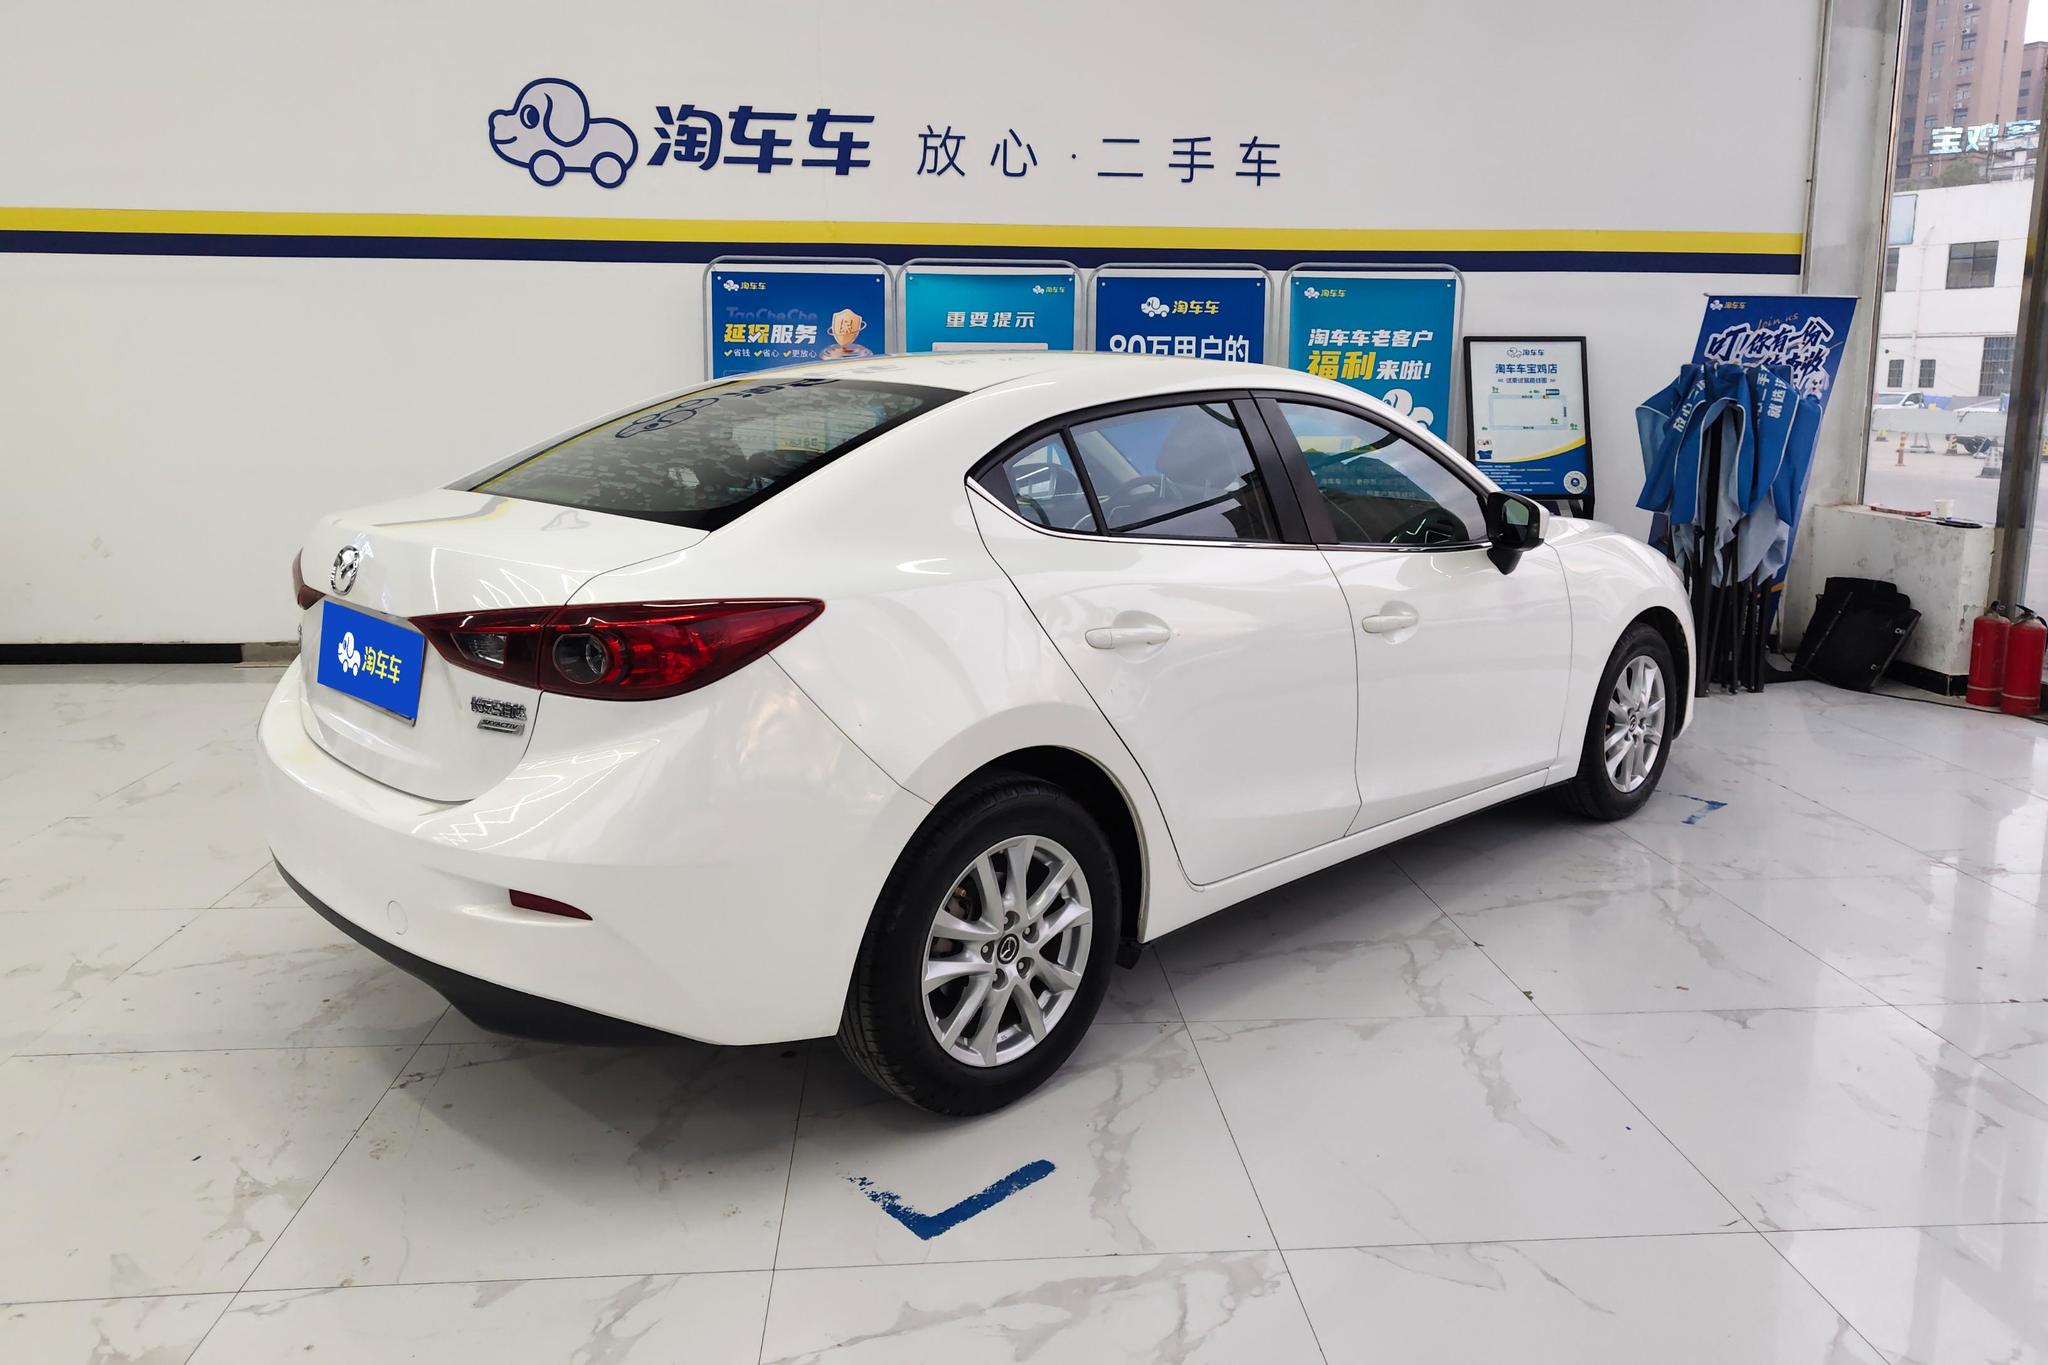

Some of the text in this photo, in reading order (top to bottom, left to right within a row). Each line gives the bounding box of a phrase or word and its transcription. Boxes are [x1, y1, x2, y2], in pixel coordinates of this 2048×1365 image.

[648, 104, 875, 176] 淘车车
[740, 281, 767, 290] 淘车车
[1045, 286, 1066, 295] 淘车车
[1320, 288, 1347, 298] 淘车车
[1172, 300, 1220, 315] 淘车车
[945, 311, 1035, 328] 重要提示
[724, 323, 817, 344] 延保服务
[1307, 329, 1433, 348] 淘车车老客户
[734, 348, 817, 359] 省钱 省心 更放心
[1495, 363, 1558, 374] 淘车车宝鸡店
[361, 646, 402, 684] 淘车车
[481, 719, 519, 730] SKYACTIV
